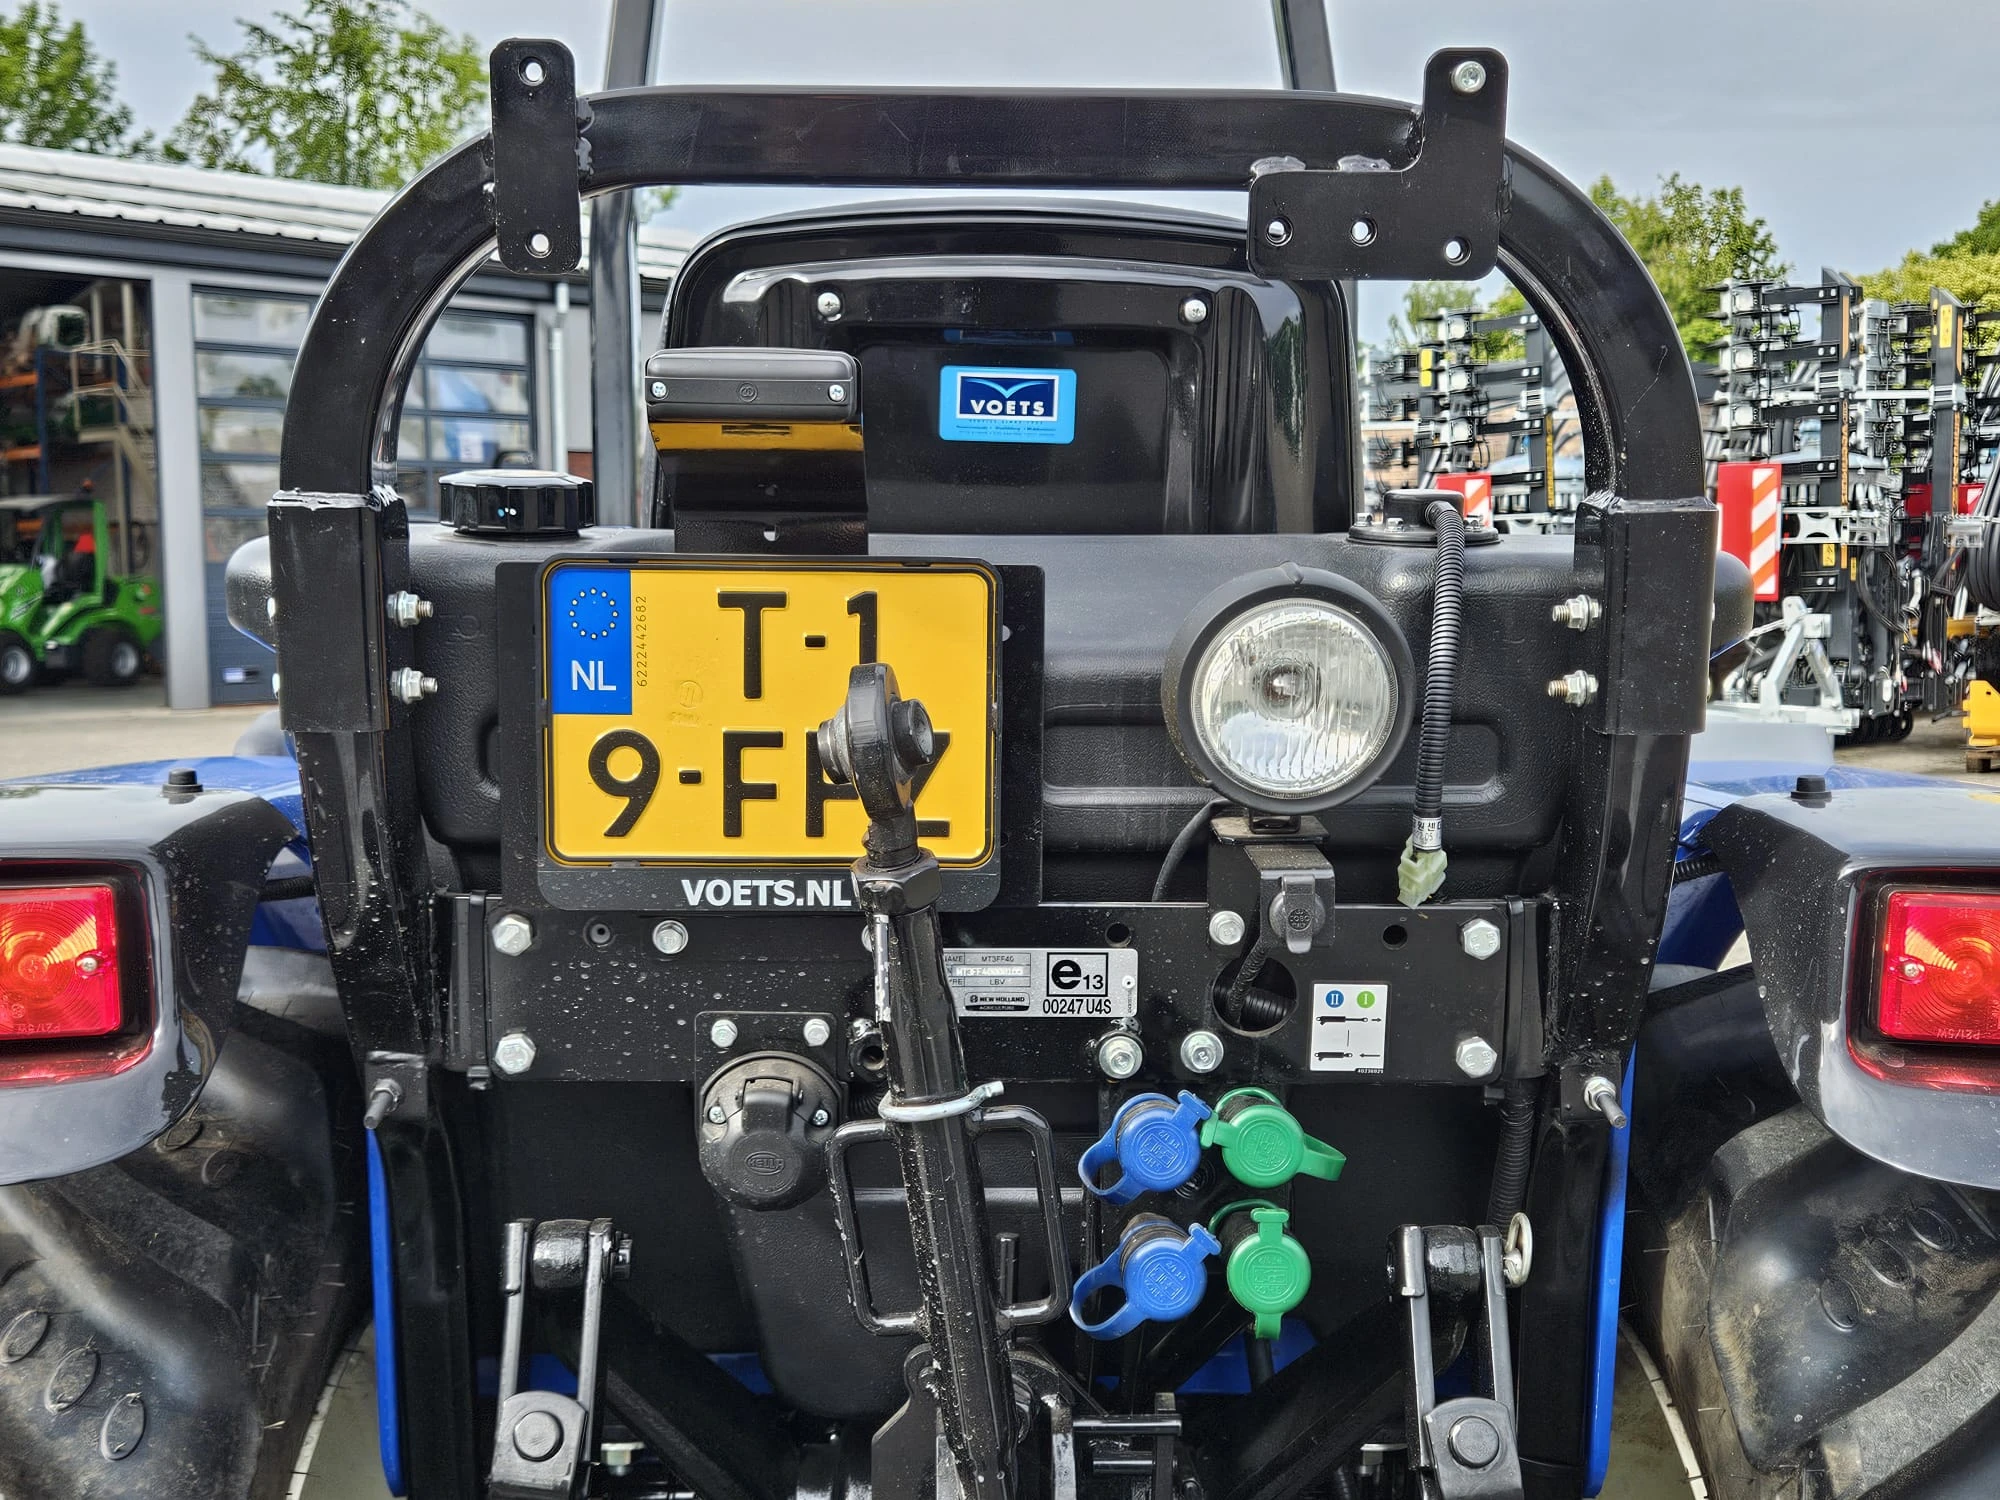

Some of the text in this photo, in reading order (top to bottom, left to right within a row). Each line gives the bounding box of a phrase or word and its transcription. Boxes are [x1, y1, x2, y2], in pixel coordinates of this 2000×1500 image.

[969, 399, 1046, 416] VOETS
[635, 595, 648, 688] 6222442682
[717, 591, 879, 700] T-1
[571, 659, 618, 691] NL
[680, 879, 853, 907] VOETS.NL
[1042, 998, 1084, 1016] 00247
[1086, 998, 1112, 1016] U4S
[748, 1158, 785, 1170] HELLA
